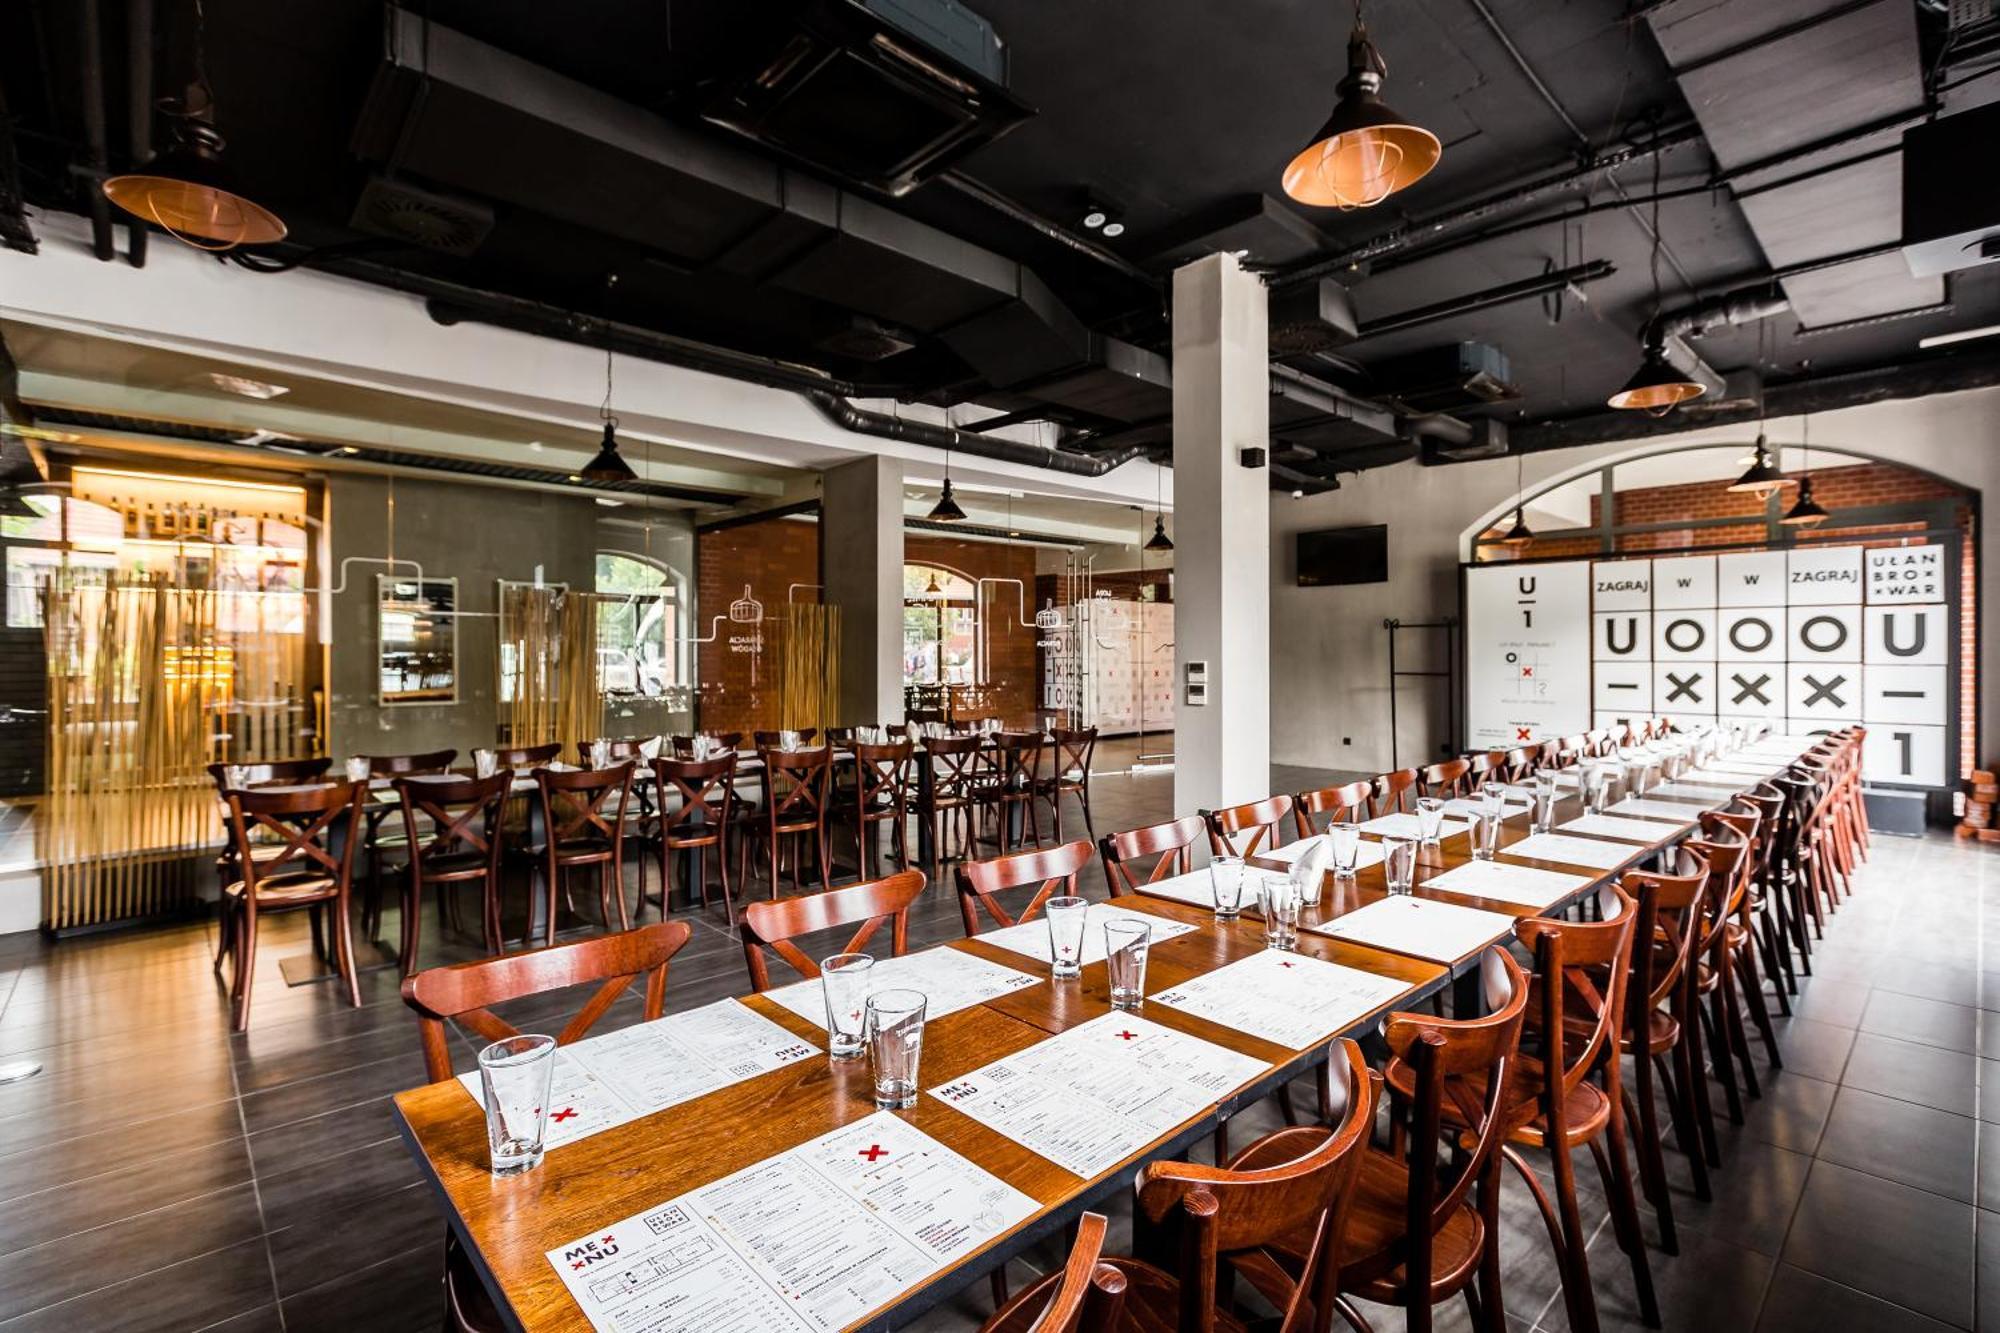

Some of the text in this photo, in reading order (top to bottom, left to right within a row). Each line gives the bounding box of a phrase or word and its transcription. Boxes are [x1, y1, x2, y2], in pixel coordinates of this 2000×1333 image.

[1519, 576, 1536, 595] U
[1677, 577, 1692, 588] W
[1744, 574, 1760, 585] W
[1792, 569, 1858, 584] ZAGRAJ
[1597, 579, 1649, 593] ZAGRAJ
[1523, 610, 1532, 628] 1
[1606, 612, 1926, 657] U O O O U
[1893, 732, 1912, 775] 1
[565, 1241, 598, 1261] ME
[584, 1244, 620, 1265] NU
